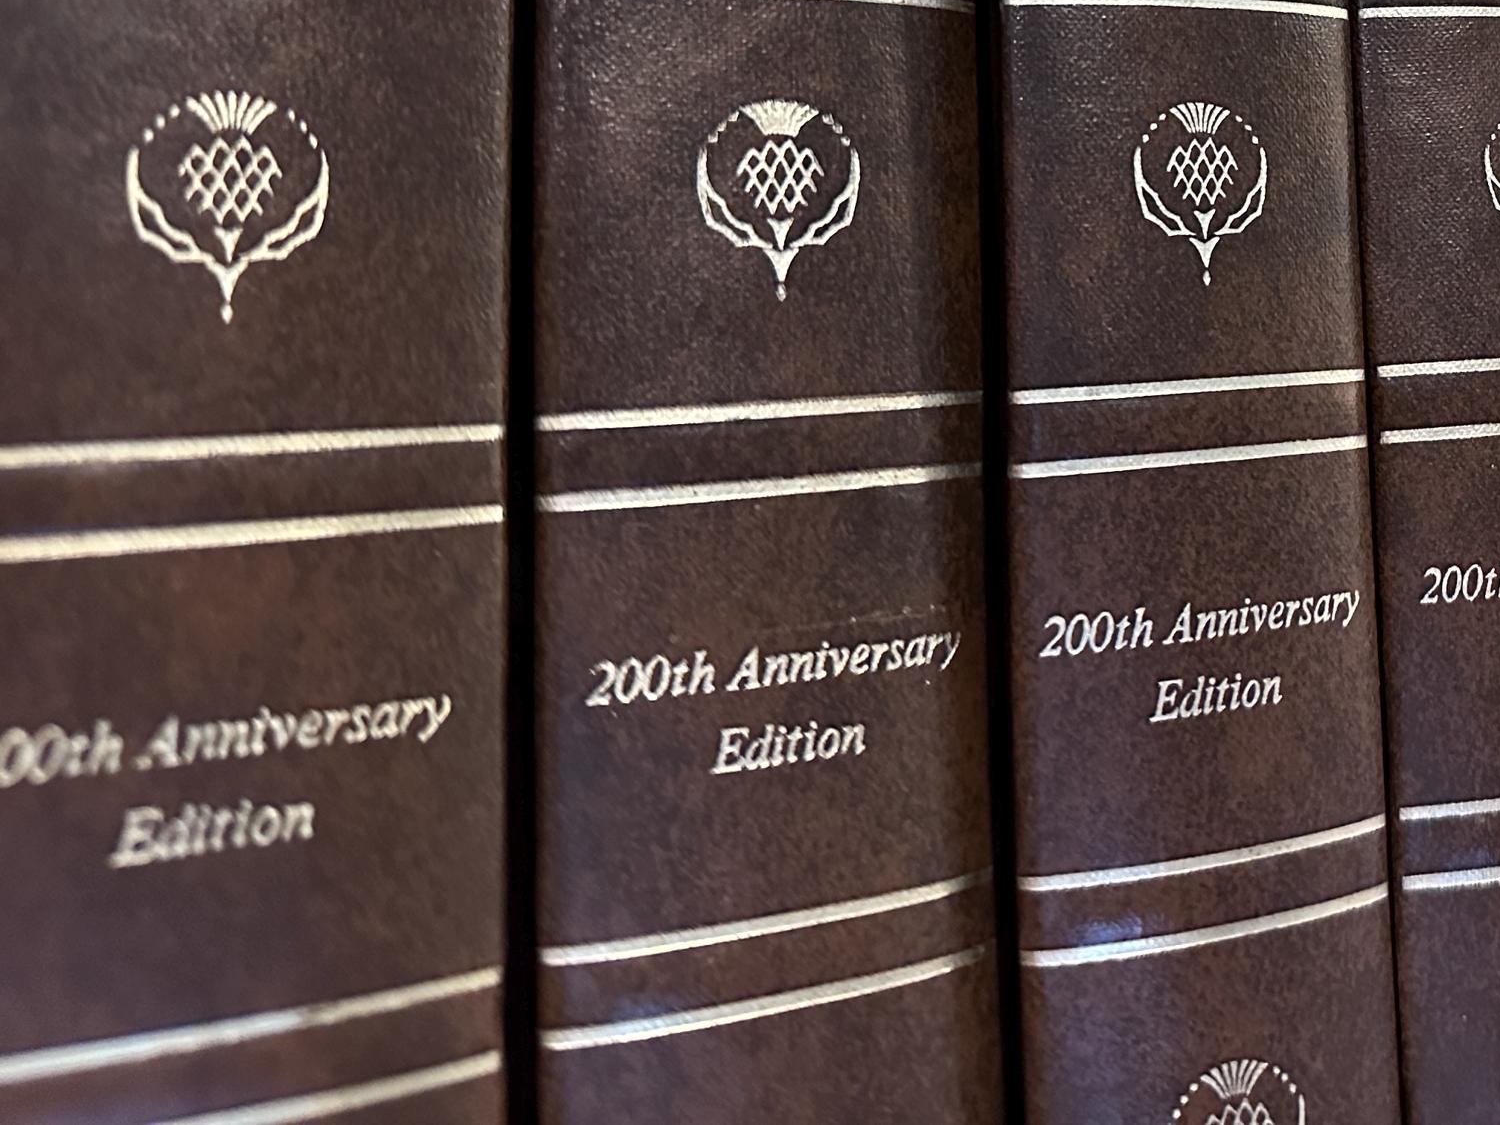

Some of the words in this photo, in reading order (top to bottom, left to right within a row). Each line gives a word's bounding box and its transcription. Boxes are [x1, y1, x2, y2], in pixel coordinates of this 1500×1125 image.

[1039, 607, 1153, 658] 200th
[1162, 590, 1360, 645] Anniversary
[585, 650, 716, 707] 200th
[725, 631, 961, 691] Anniversary
[1149, 673, 1282, 723] Edition
[0, 717, 123, 788] 00th
[131, 694, 452, 770] Anniversary
[710, 720, 866, 774] Edition
[108, 798, 315, 869] Edition
